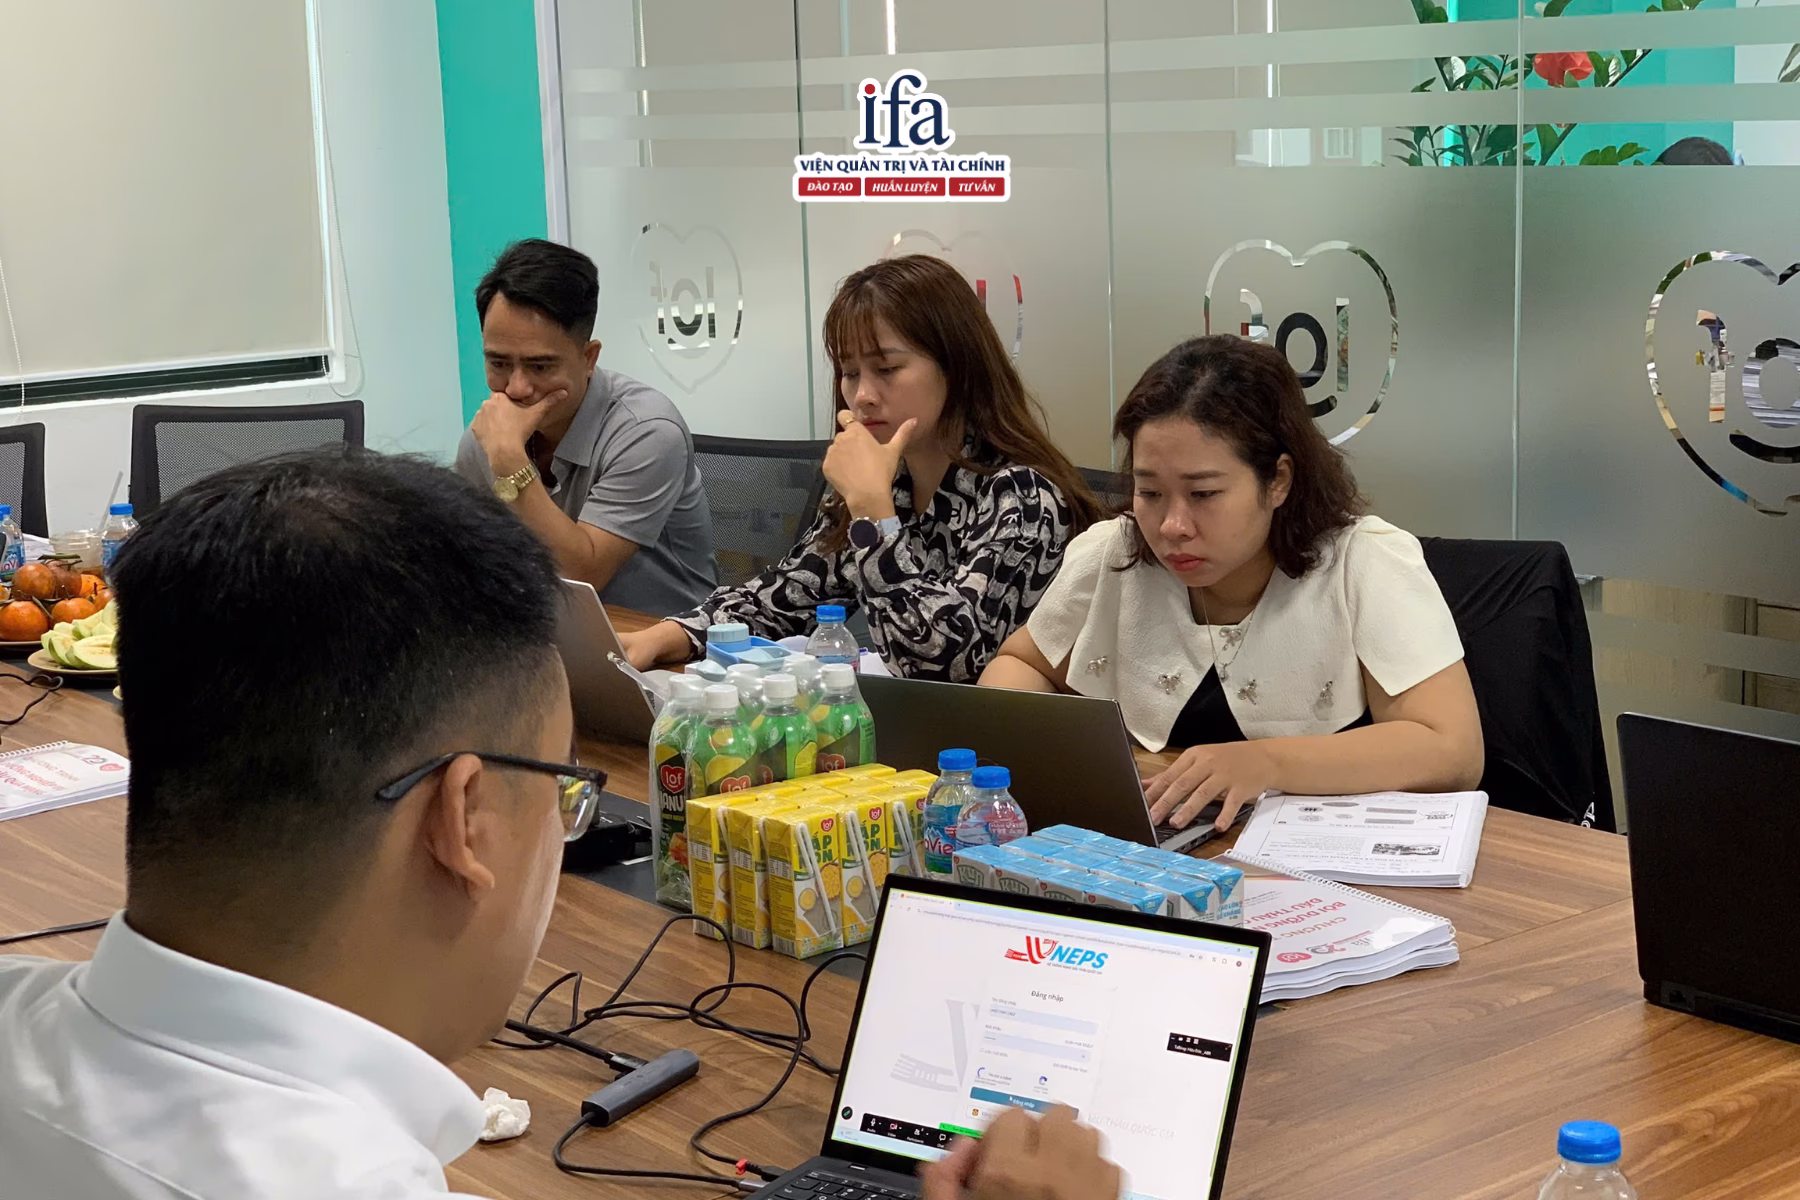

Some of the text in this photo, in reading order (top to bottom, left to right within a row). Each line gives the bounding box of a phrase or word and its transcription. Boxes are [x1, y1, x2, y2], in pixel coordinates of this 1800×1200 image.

[821, 760, 840, 771] lof
[665, 771, 682, 785] lof
[1049, 945, 1109, 969] NEPS
